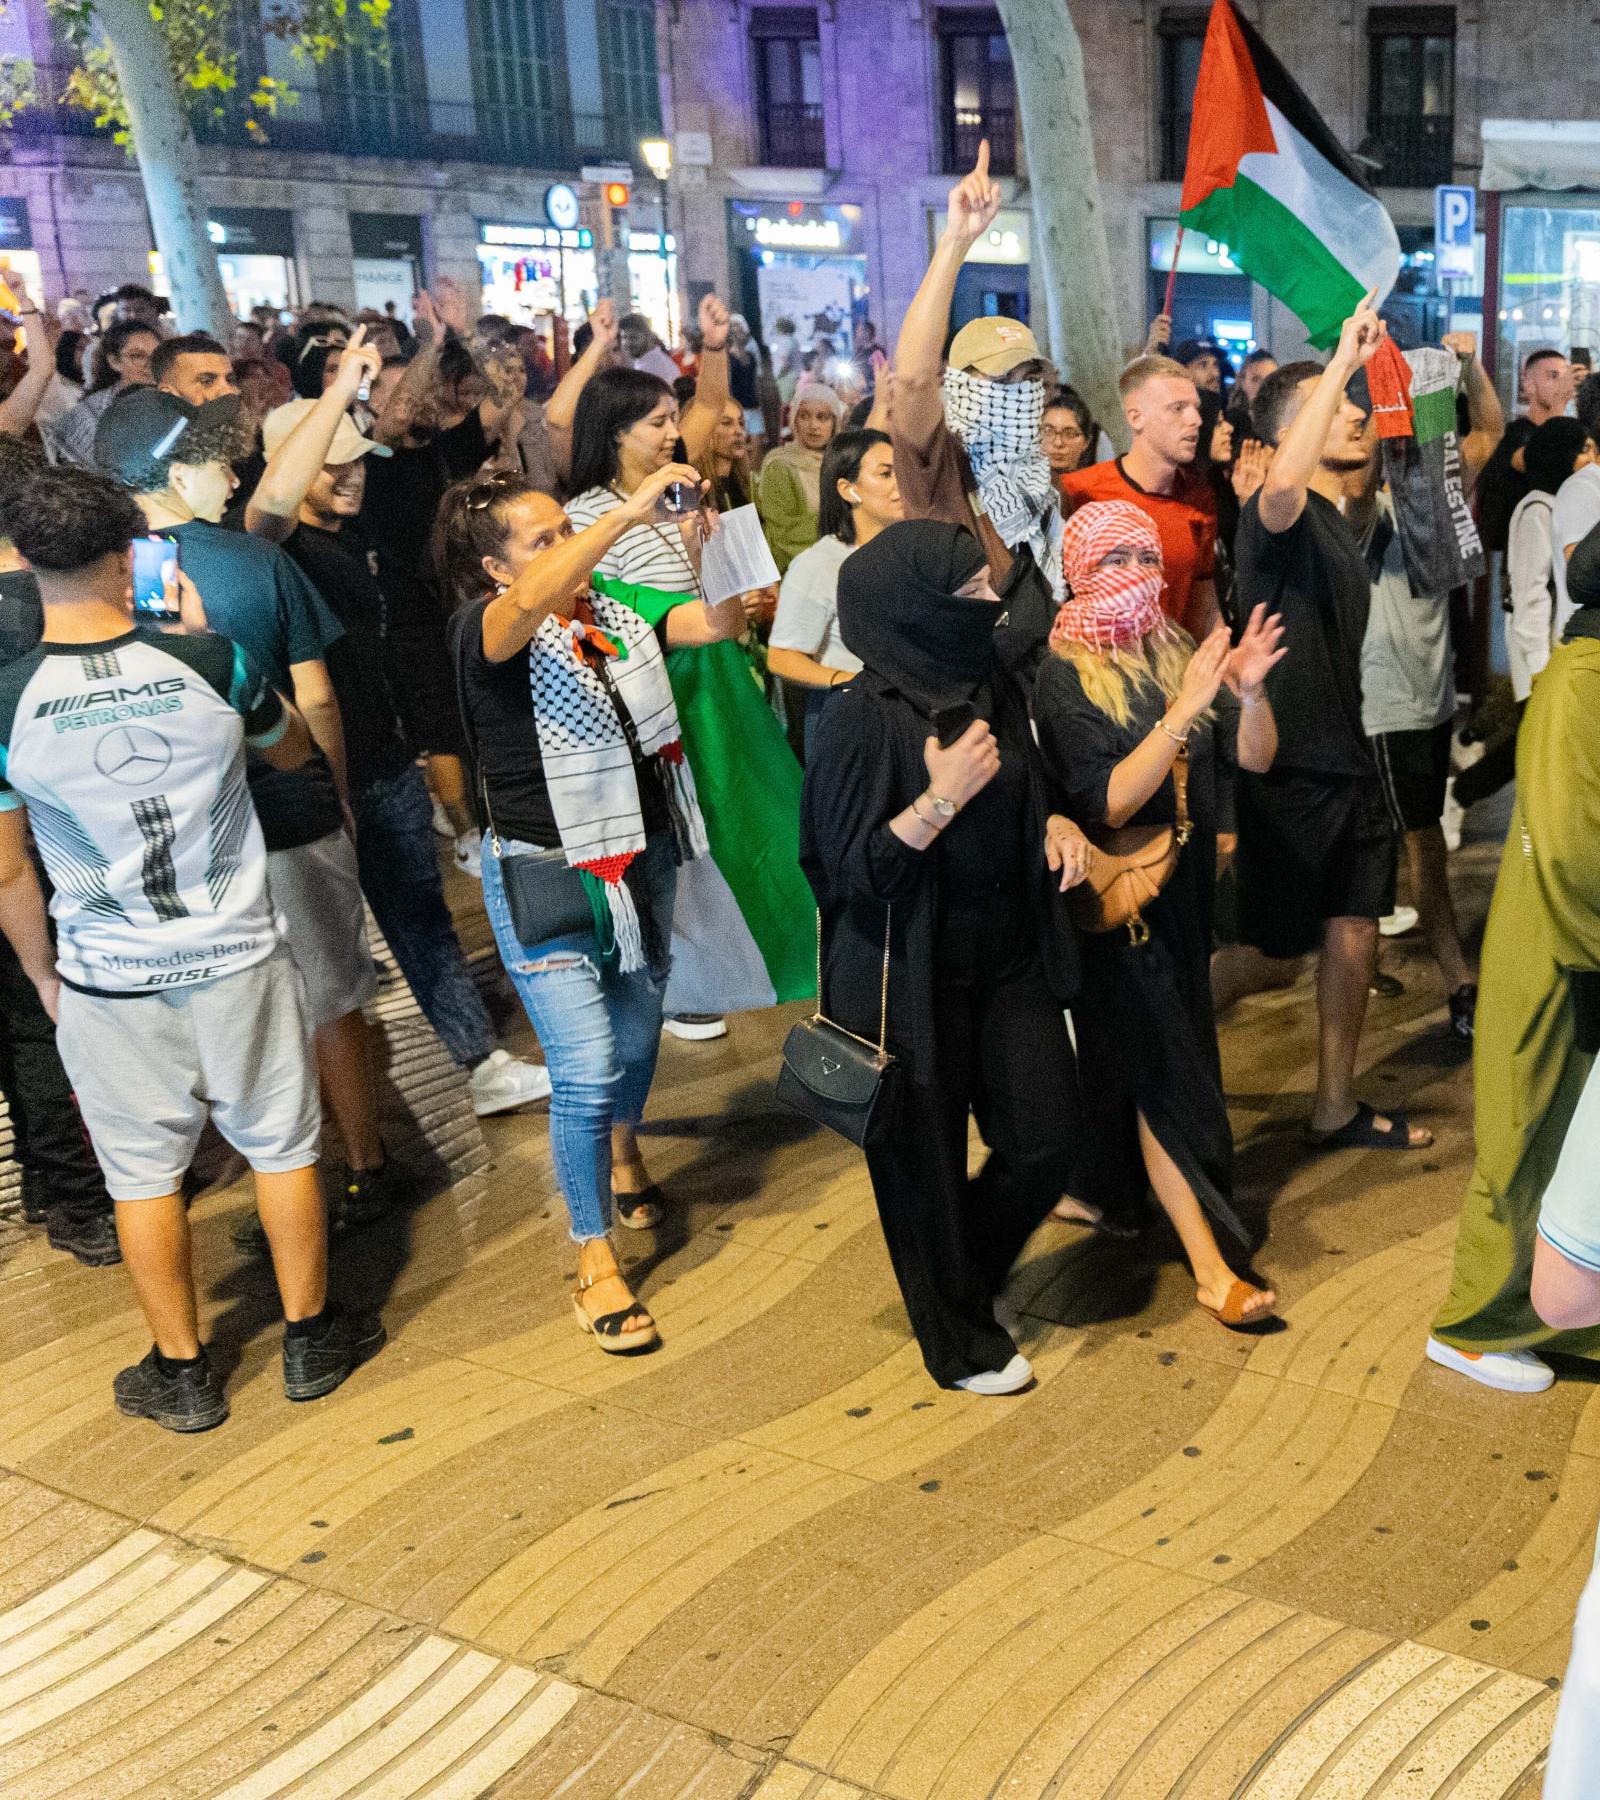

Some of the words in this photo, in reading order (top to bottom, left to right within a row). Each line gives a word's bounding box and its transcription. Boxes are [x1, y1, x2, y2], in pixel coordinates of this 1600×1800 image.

[1444, 192, 1469, 241] P
[83, 677, 187, 708] AMG
[53, 695, 184, 734] PETRONAS
[102, 937, 257, 971] Mercedes-Benz
[132, 963, 228, 987] BOSE
